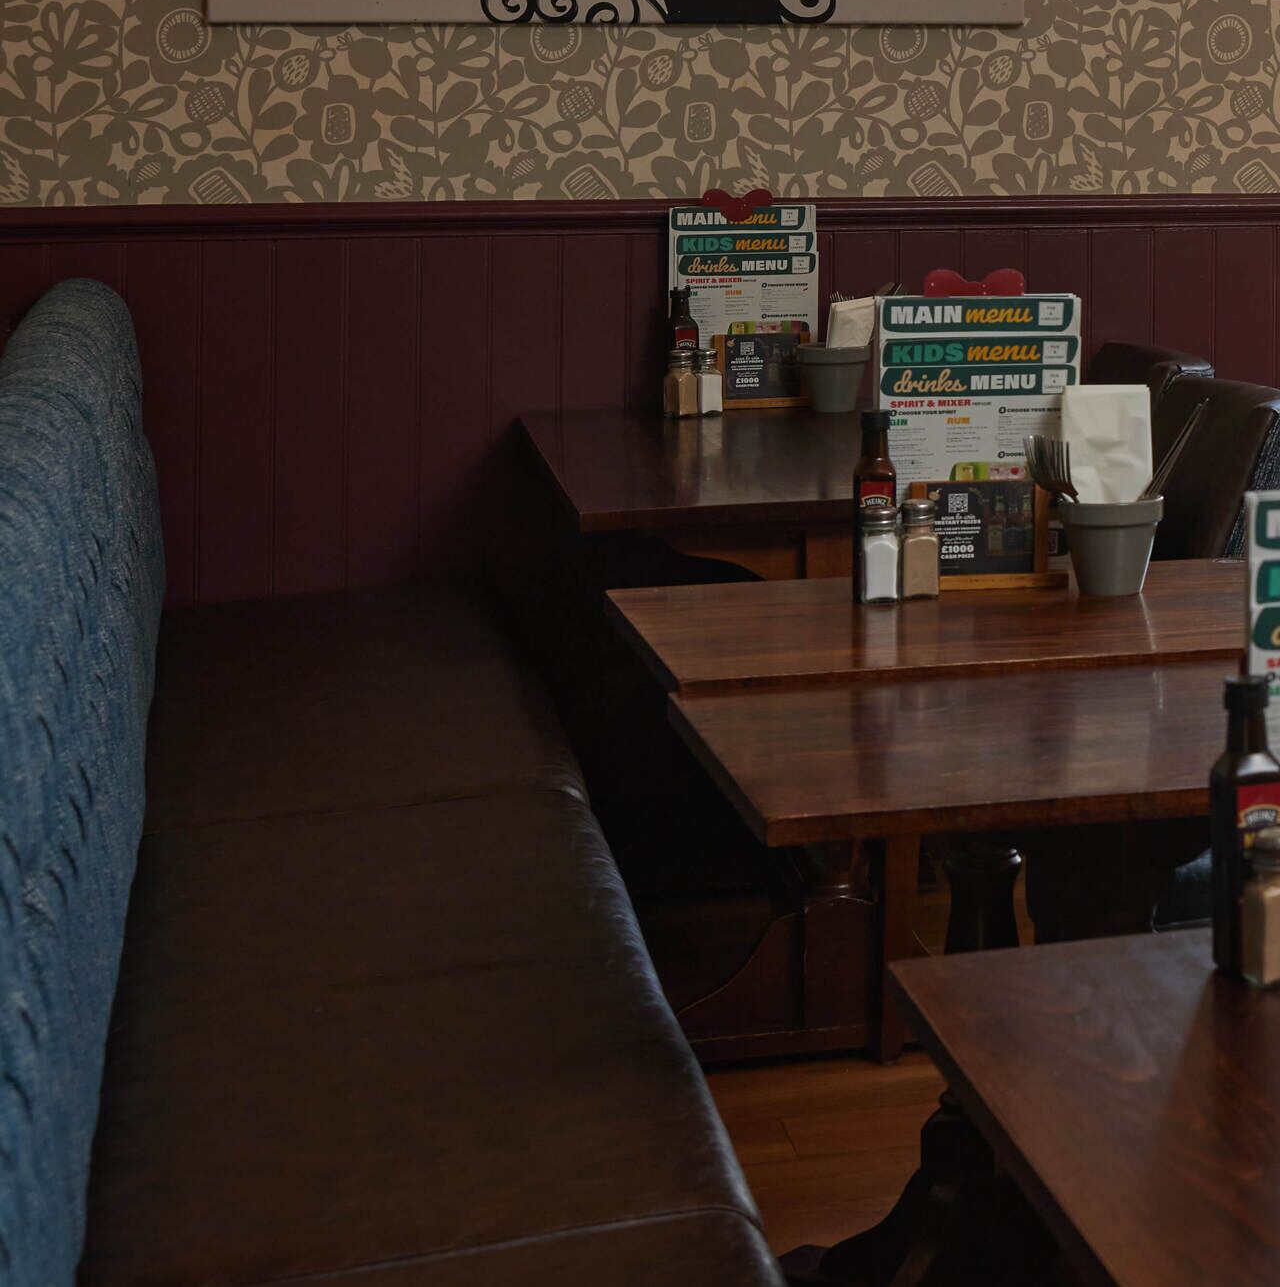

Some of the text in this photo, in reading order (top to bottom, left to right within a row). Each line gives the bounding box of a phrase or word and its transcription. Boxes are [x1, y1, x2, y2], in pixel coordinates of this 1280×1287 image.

[682, 236, 734, 252] KIDS
[735, 237, 788, 252] menu
[687, 255, 739, 274] drinks
[741, 259, 788, 271] MENU
[890, 305, 1034, 325] MAIN menu
[890, 343, 964, 364] KIDS
[966, 344, 1041, 362] menu
[735, 377, 760, 385] £1000
[892, 368, 968, 394] drinks
[970, 373, 1037, 391] MENU
[889, 400, 925, 408] SPIRIT
[927, 400, 935, 408] &
[937, 399, 971, 407] MIXER
[890, 418, 908, 426] GIN
[865, 496, 888, 507] HEINZ
[941, 544, 975, 554] £1000
